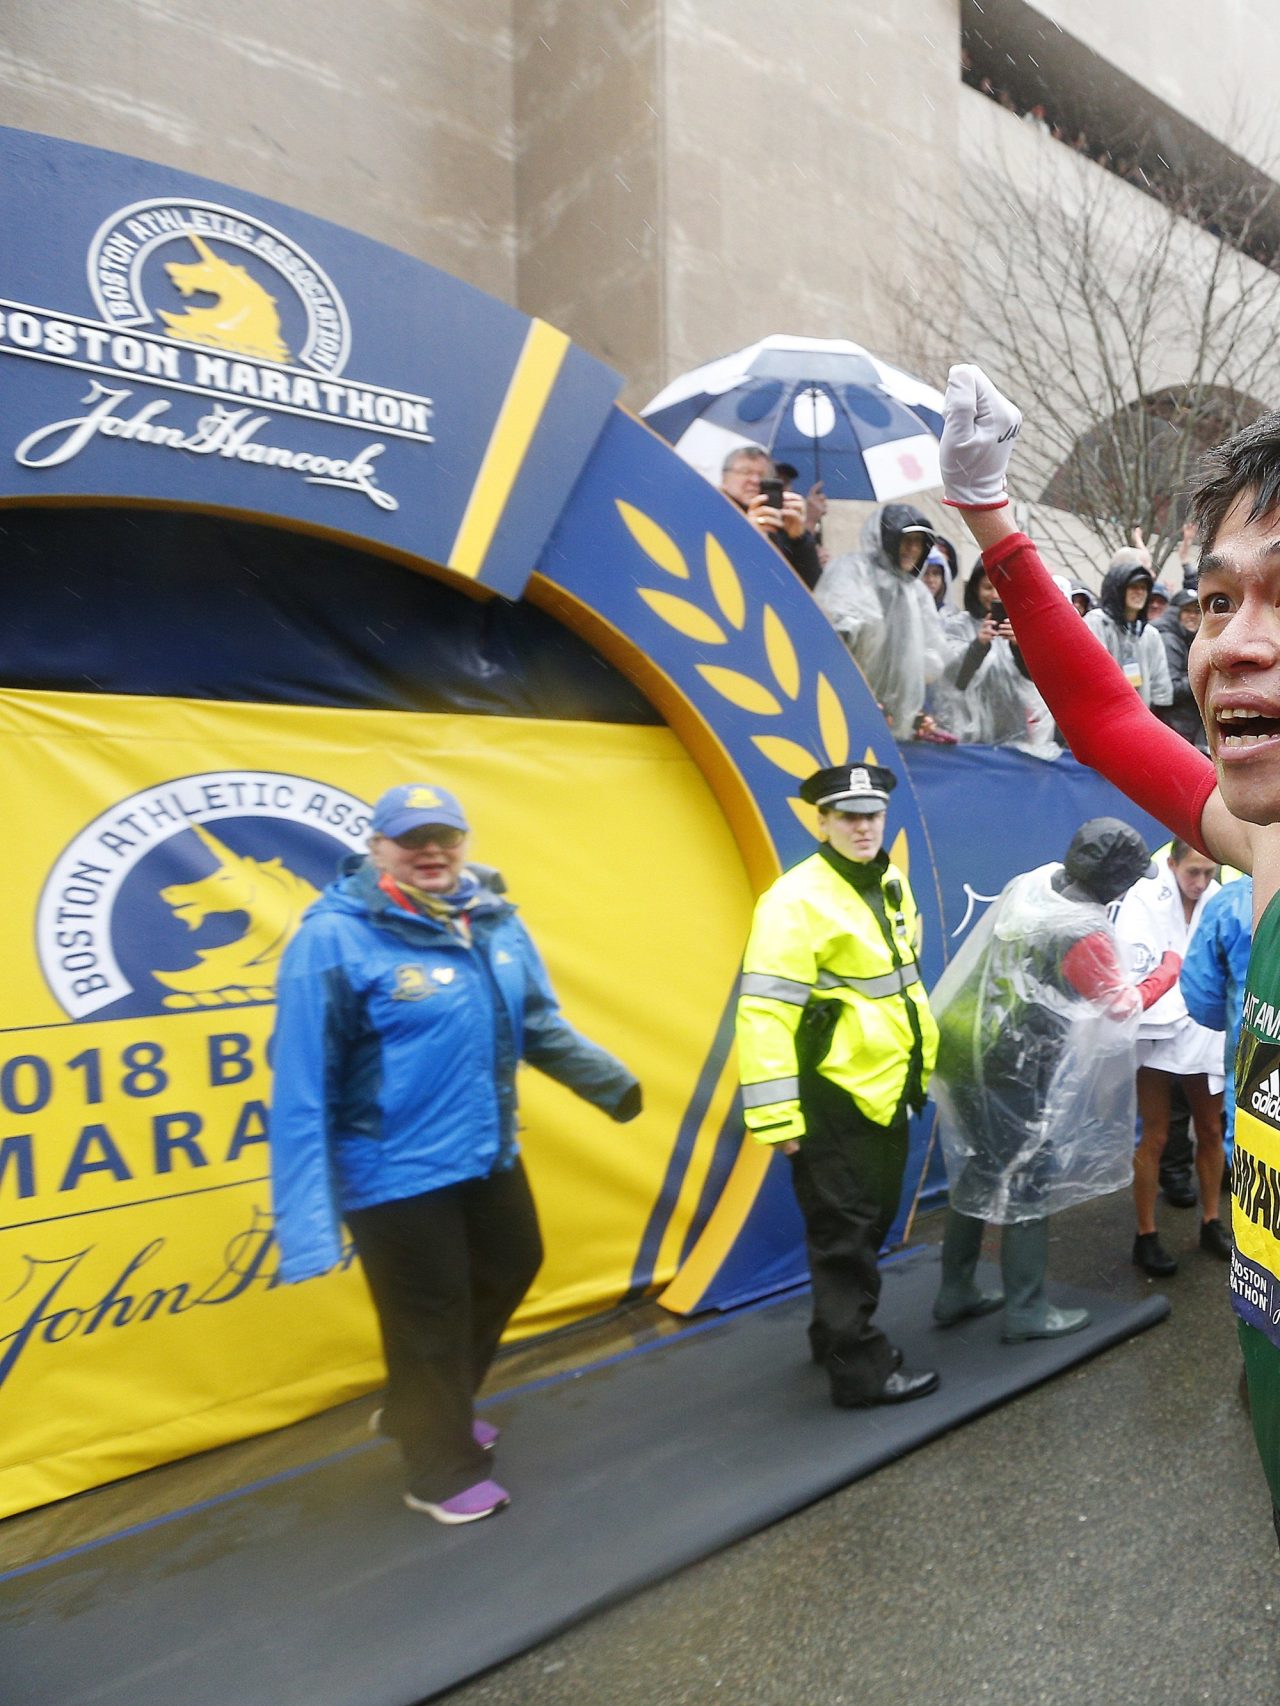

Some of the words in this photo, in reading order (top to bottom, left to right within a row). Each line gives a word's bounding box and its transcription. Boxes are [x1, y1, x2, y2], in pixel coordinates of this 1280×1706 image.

[99, 231, 139, 317] BOSTON
[125, 207, 255, 245] ATHLETIC
[252, 233, 343, 368] ASSOCIATION
[0, 311, 181, 380] OSTON
[195, 352, 432, 434] MARATHON
[14, 378, 187, 468] John
[182, 402, 400, 511] Hancock
[55, 861, 113, 999] BOSTON
[98, 782, 295, 858] ATHLETIC
[0, 1041, 169, 1115] 018
